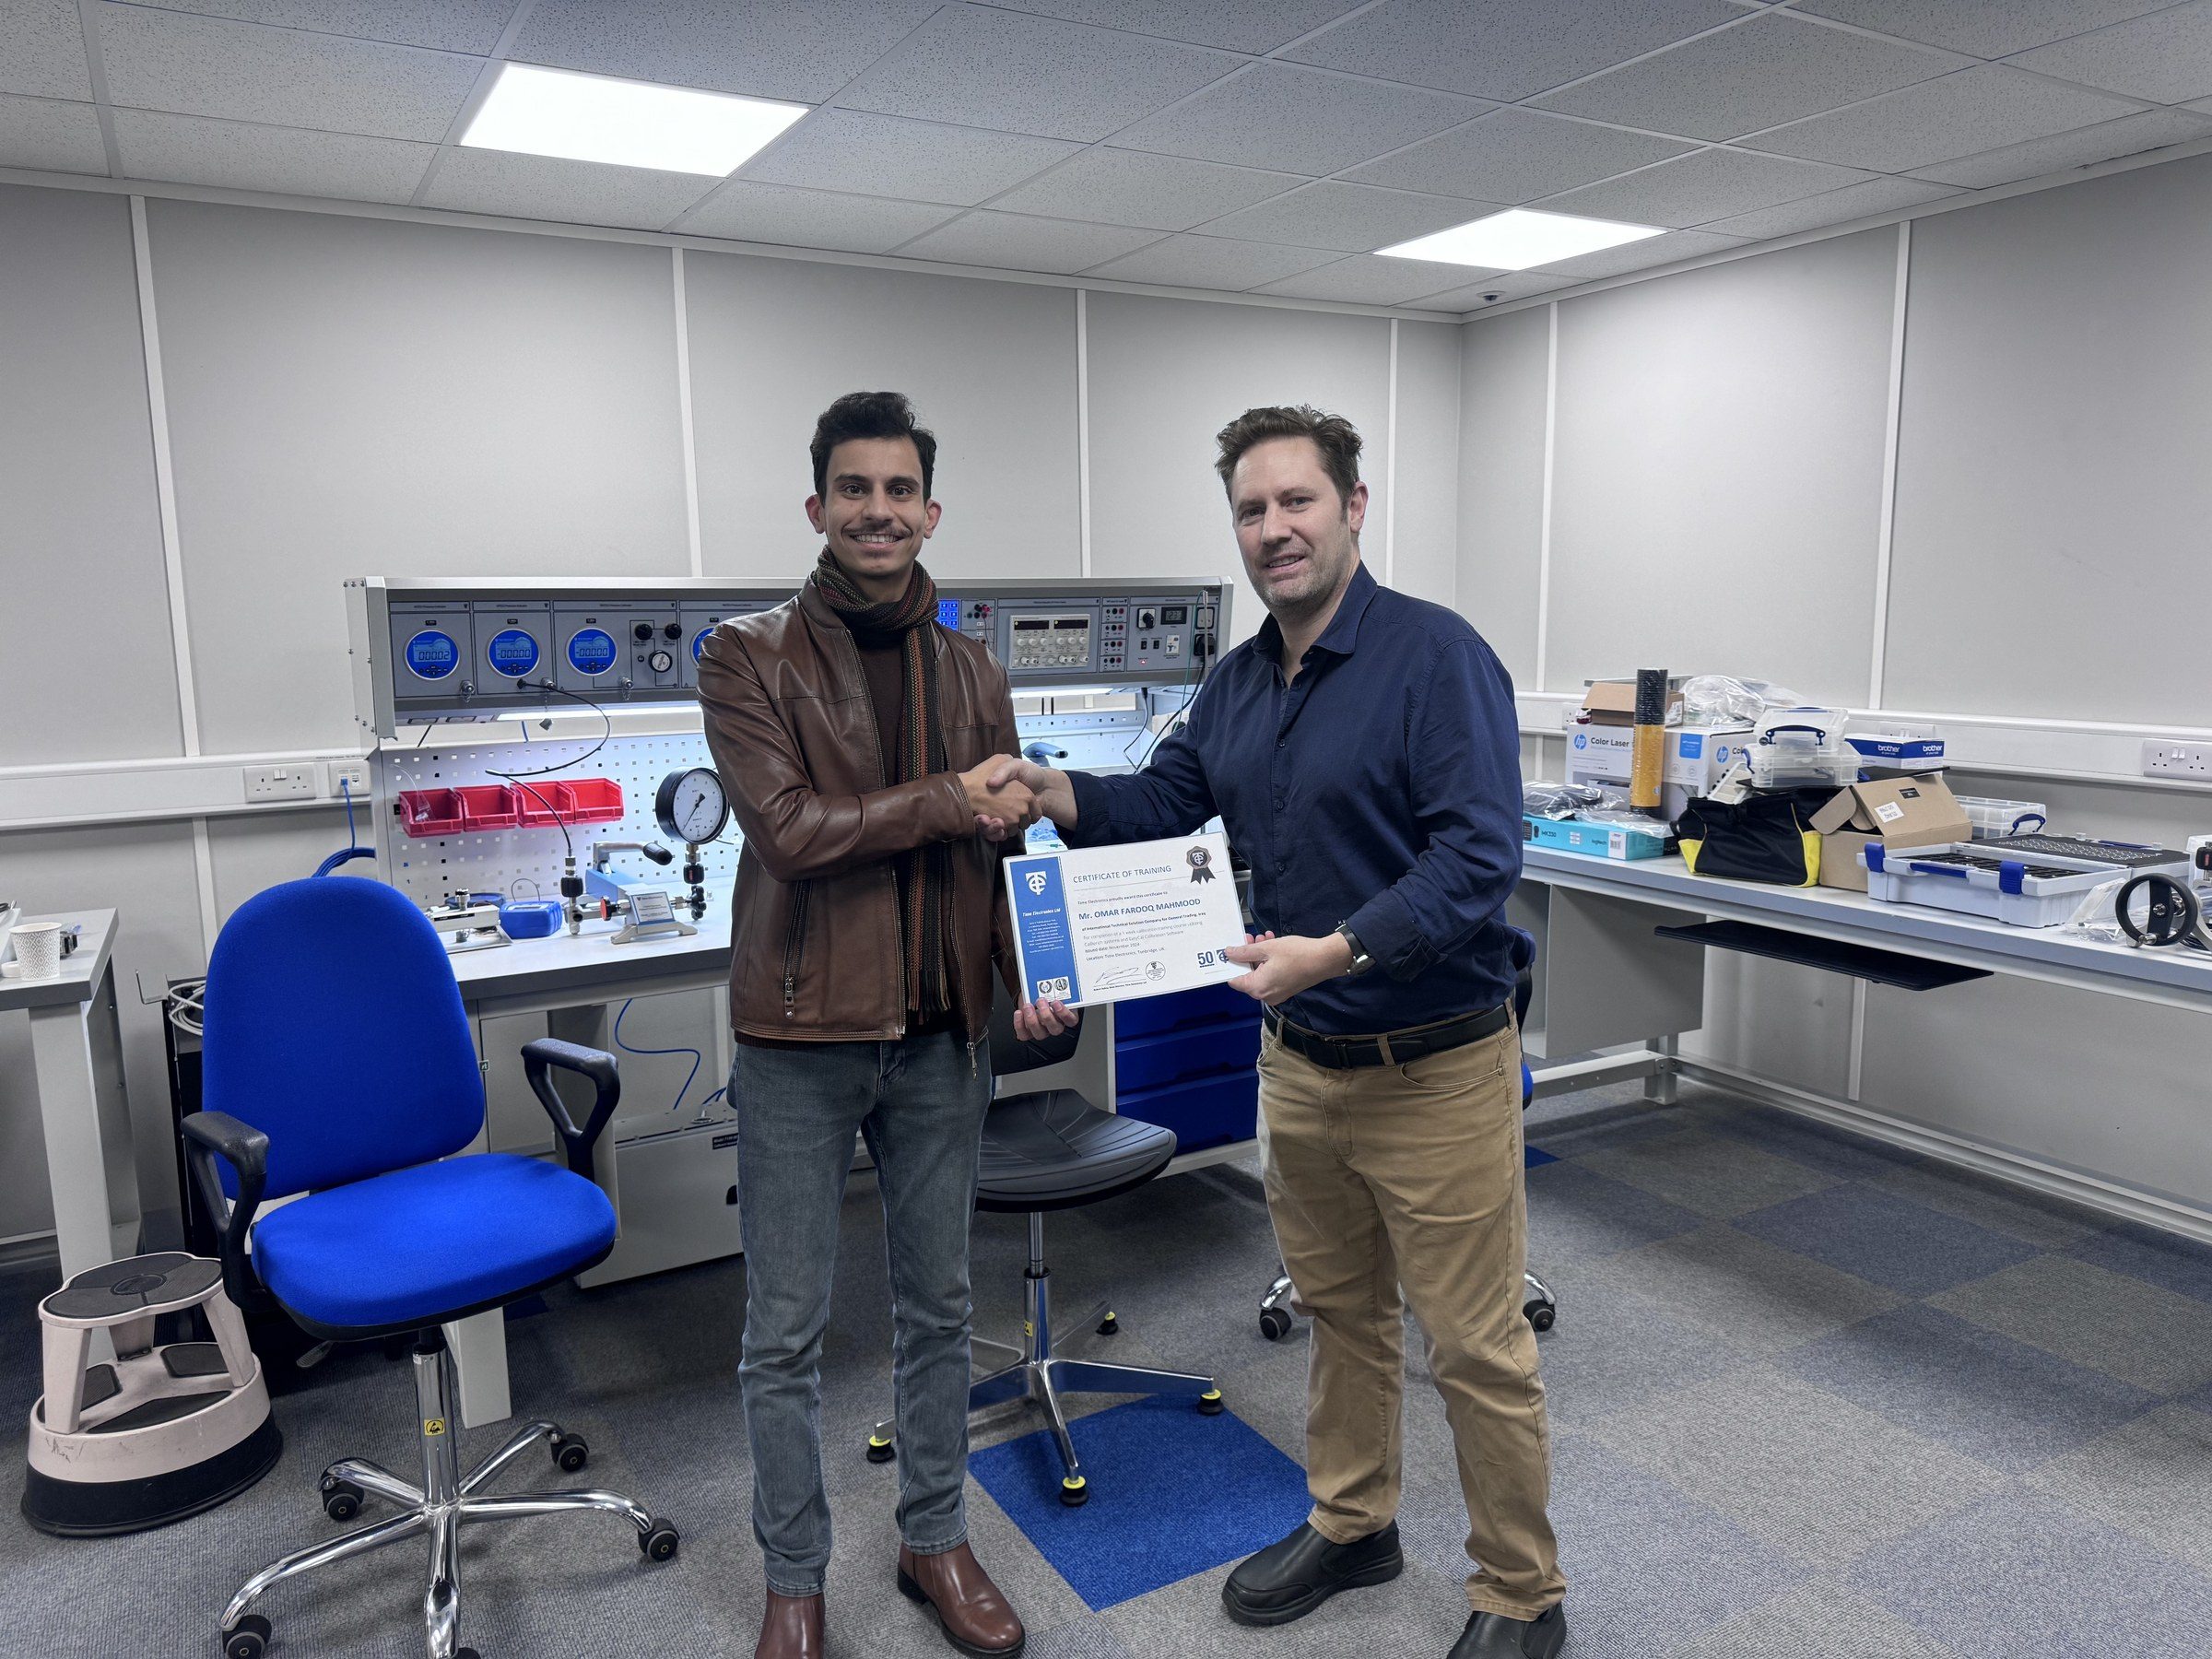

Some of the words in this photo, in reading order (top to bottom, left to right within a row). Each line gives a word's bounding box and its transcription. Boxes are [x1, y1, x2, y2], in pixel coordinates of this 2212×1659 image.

[1574, 735, 1586, 749] hp
[1591, 737, 1609, 746] Color
[1611, 738, 1630, 747] Laser
[1877, 745, 1900, 753] brother
[1073, 870, 1120, 884] CERTIFICATE
[1122, 869, 1133, 877] OF
[1135, 864, 1171, 877] TRAINING
[1079, 912, 1093, 921] Mr.
[1095, 908, 1119, 919] OMAR
[1121, 903, 1155, 917] FAROOQ
[1156, 897, 1201, 911] MAHMOOD
[1197, 950, 1214, 965] 50
